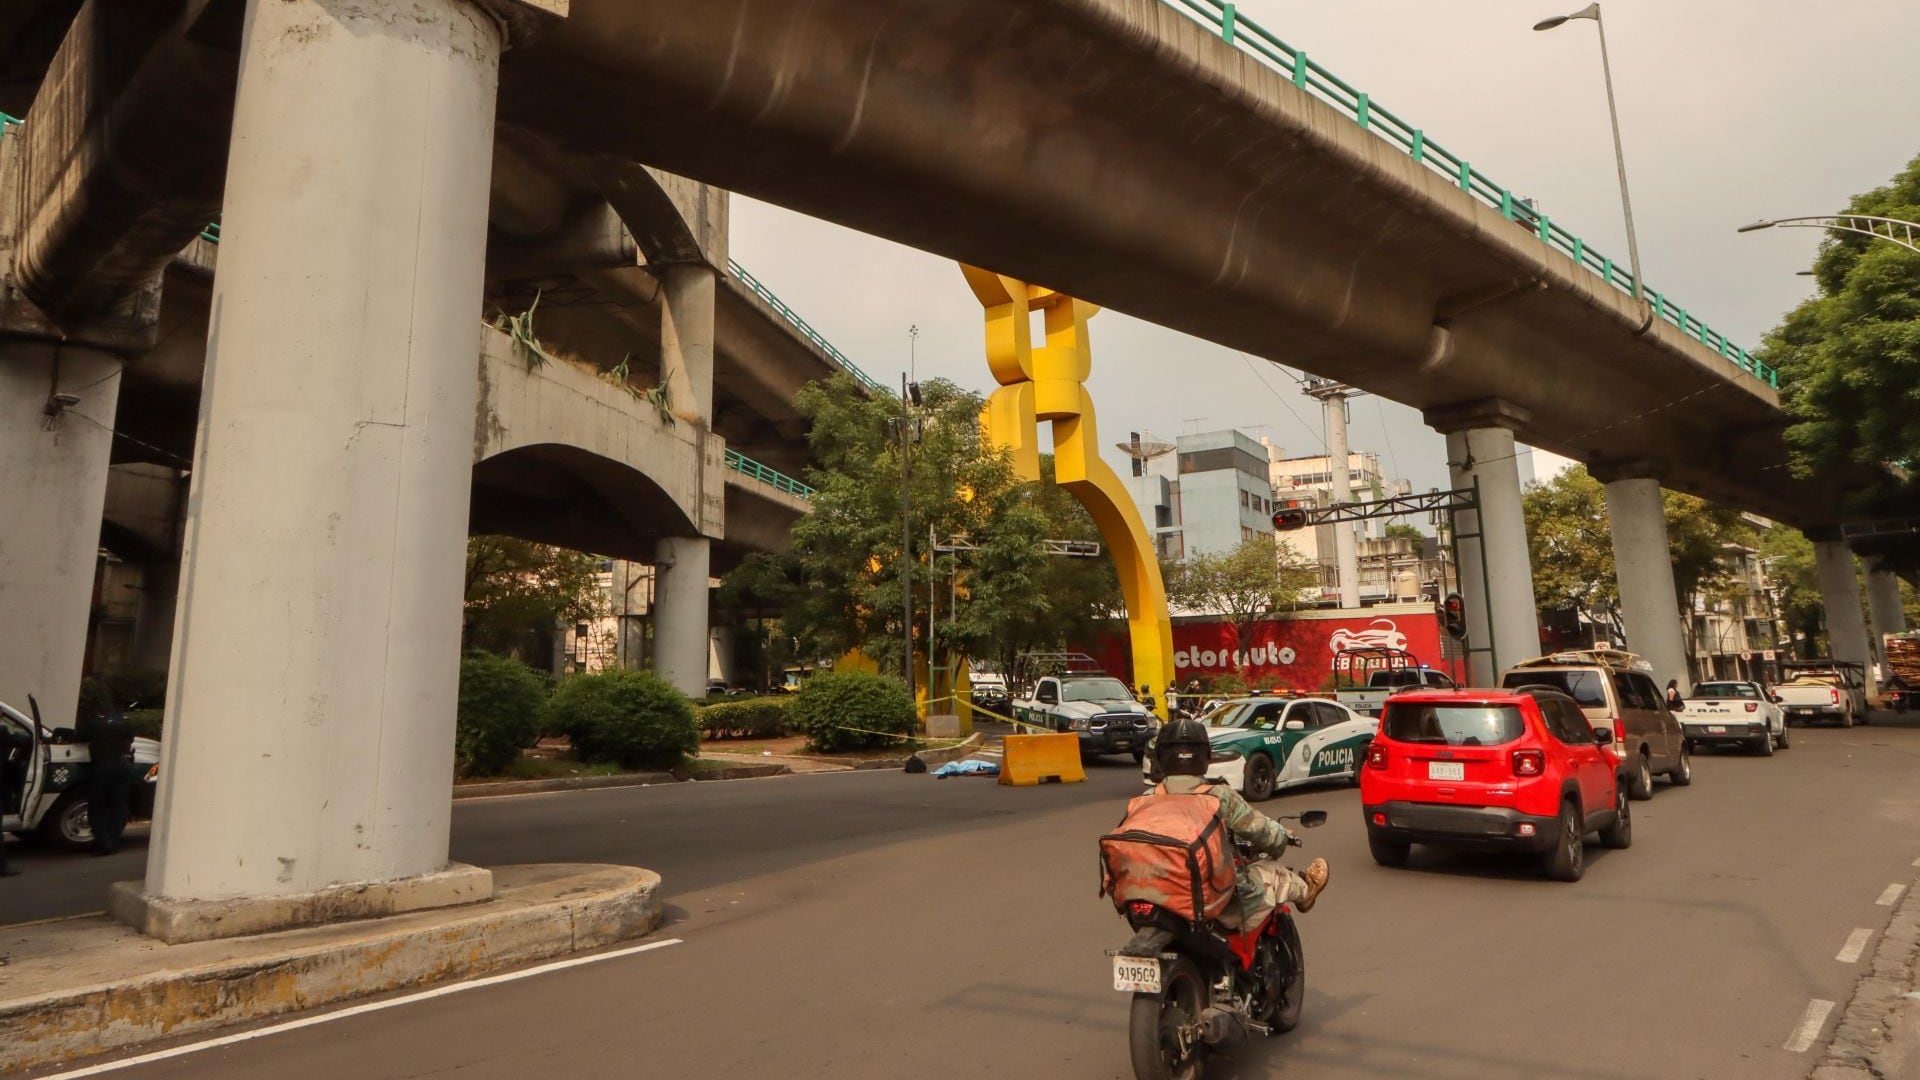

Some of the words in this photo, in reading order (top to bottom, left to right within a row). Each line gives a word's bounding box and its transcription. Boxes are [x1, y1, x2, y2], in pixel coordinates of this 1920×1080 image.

[1232, 641, 1296, 667] auto
[1028, 711, 1044, 723] POLICIA
[1318, 748, 1354, 767] POLICIA
[1118, 966, 1156, 982] 9195C9
